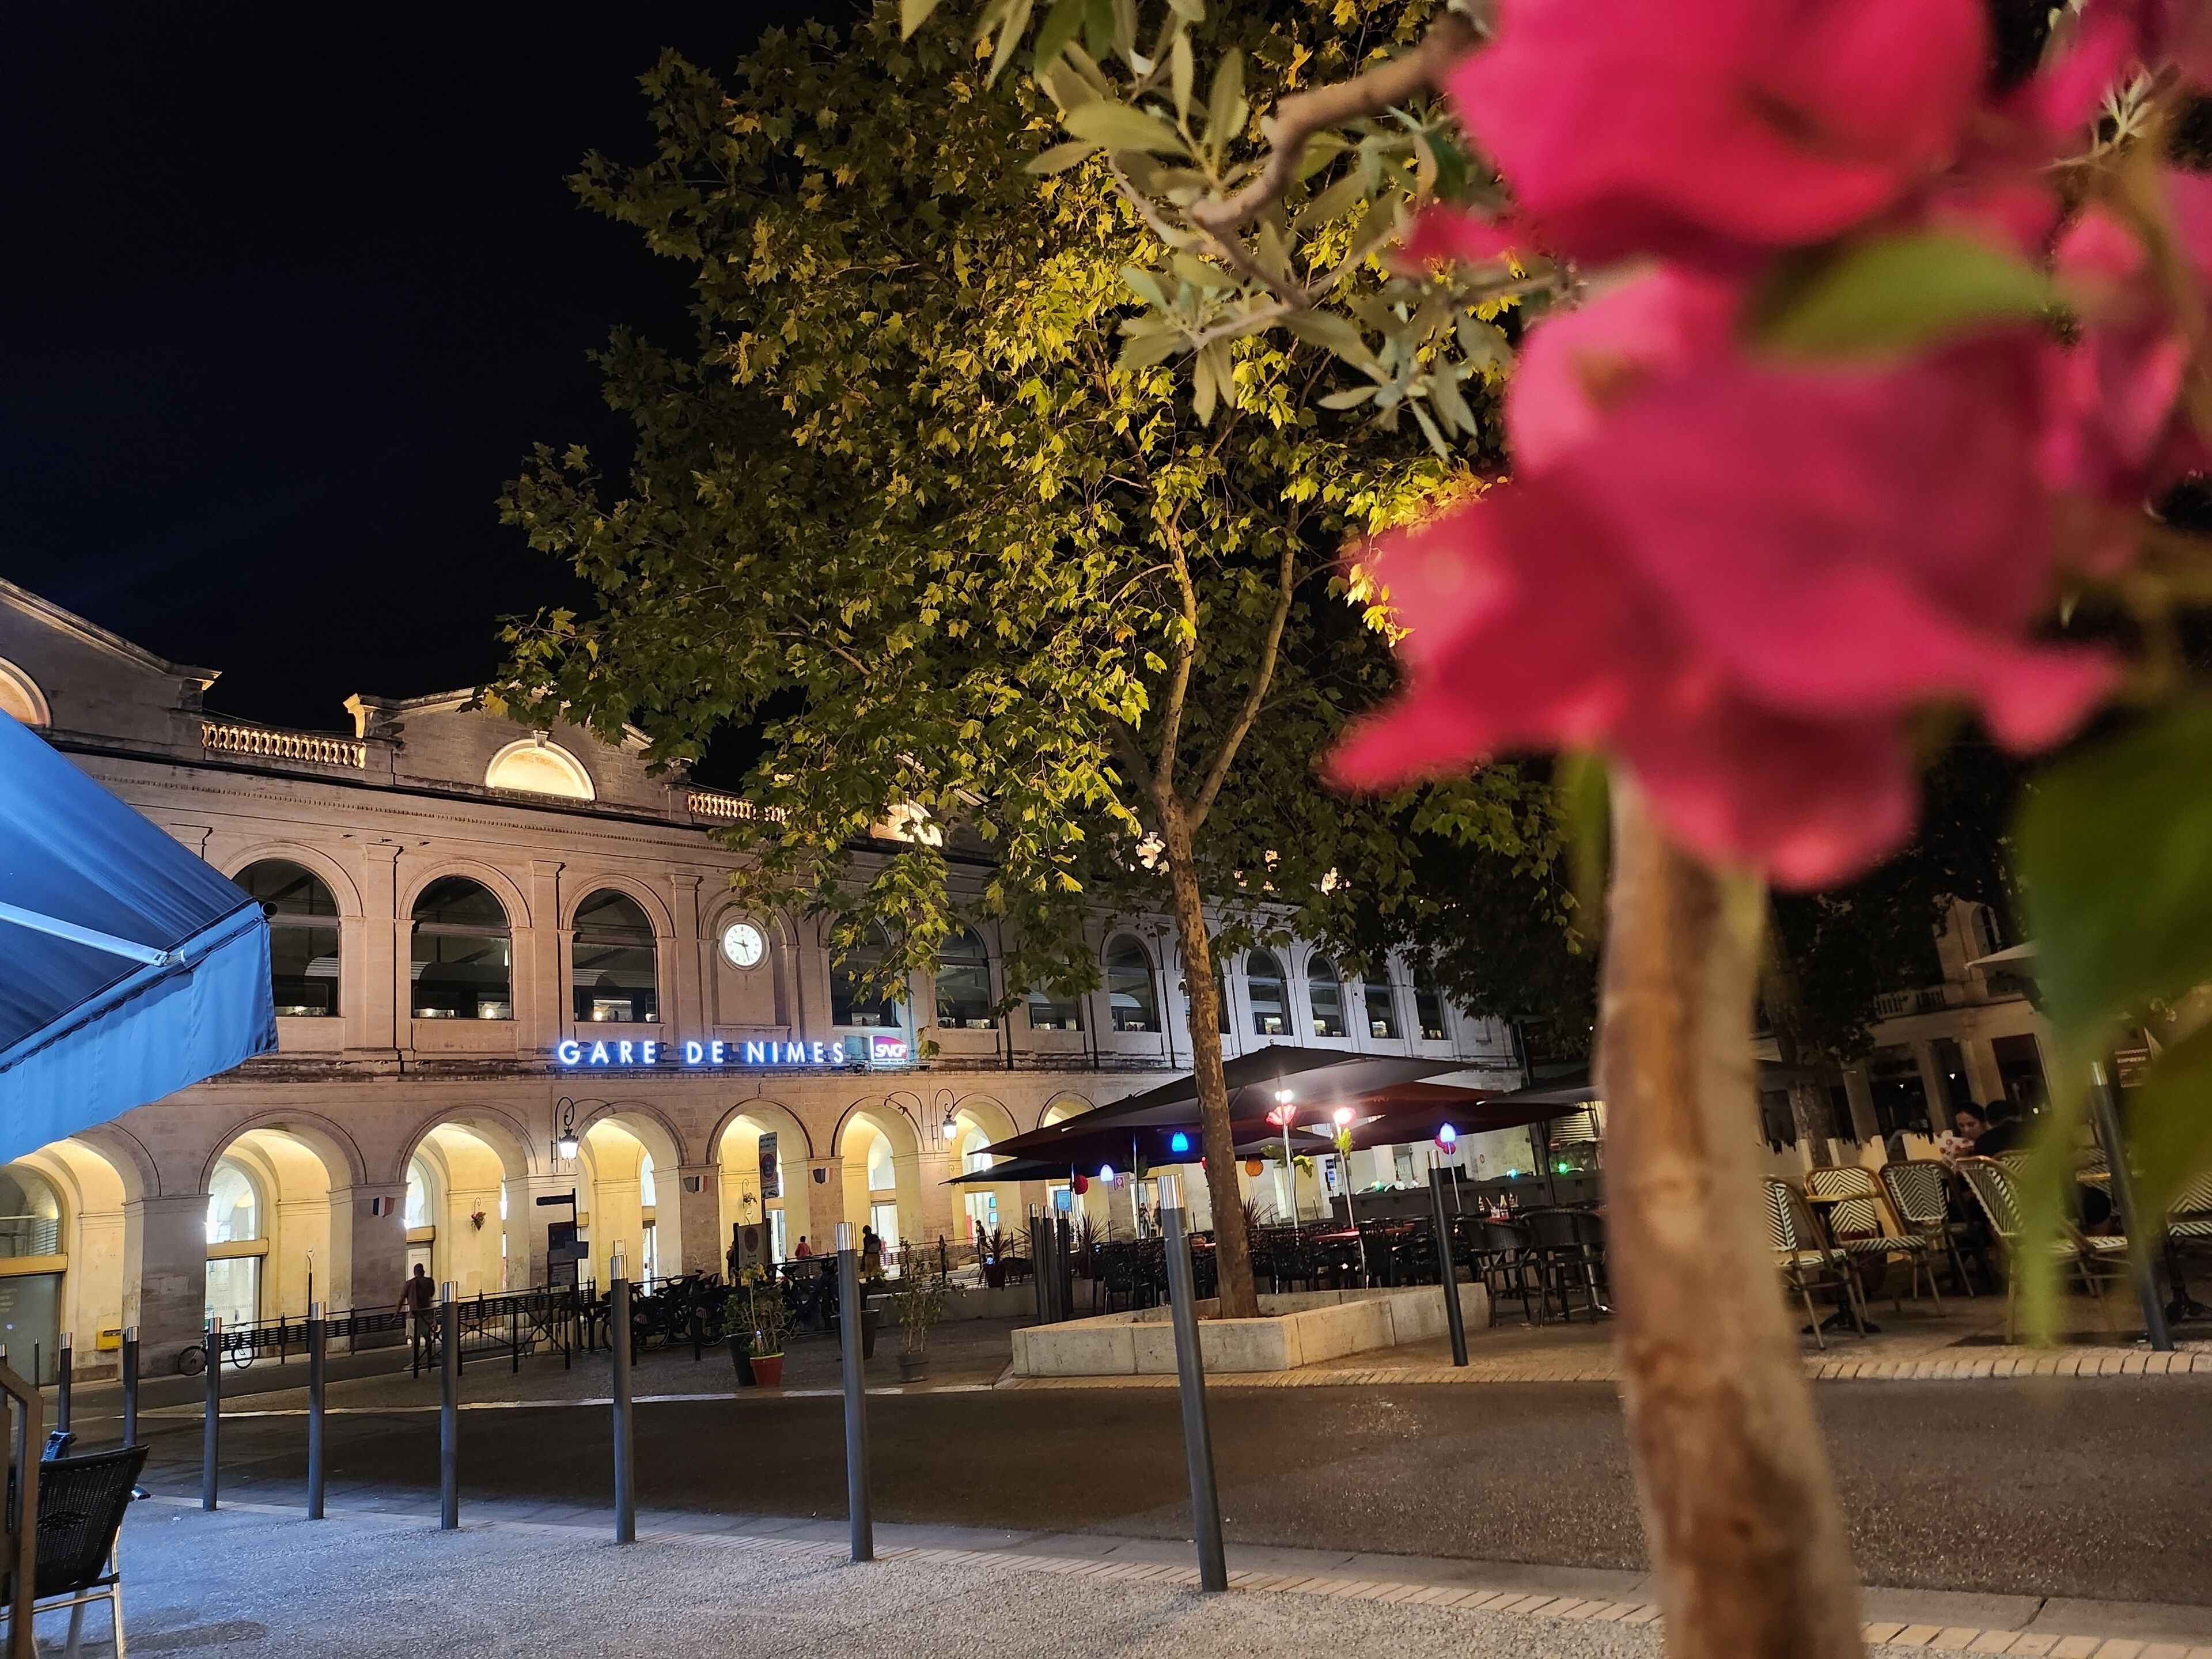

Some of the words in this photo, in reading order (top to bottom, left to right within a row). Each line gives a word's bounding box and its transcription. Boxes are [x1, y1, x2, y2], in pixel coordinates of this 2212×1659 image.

[559, 1040, 656, 1065] GARE
[686, 1041, 724, 1064] DE
[747, 1041, 844, 1064] NIMES
[874, 1044, 907, 1058] SNCF
